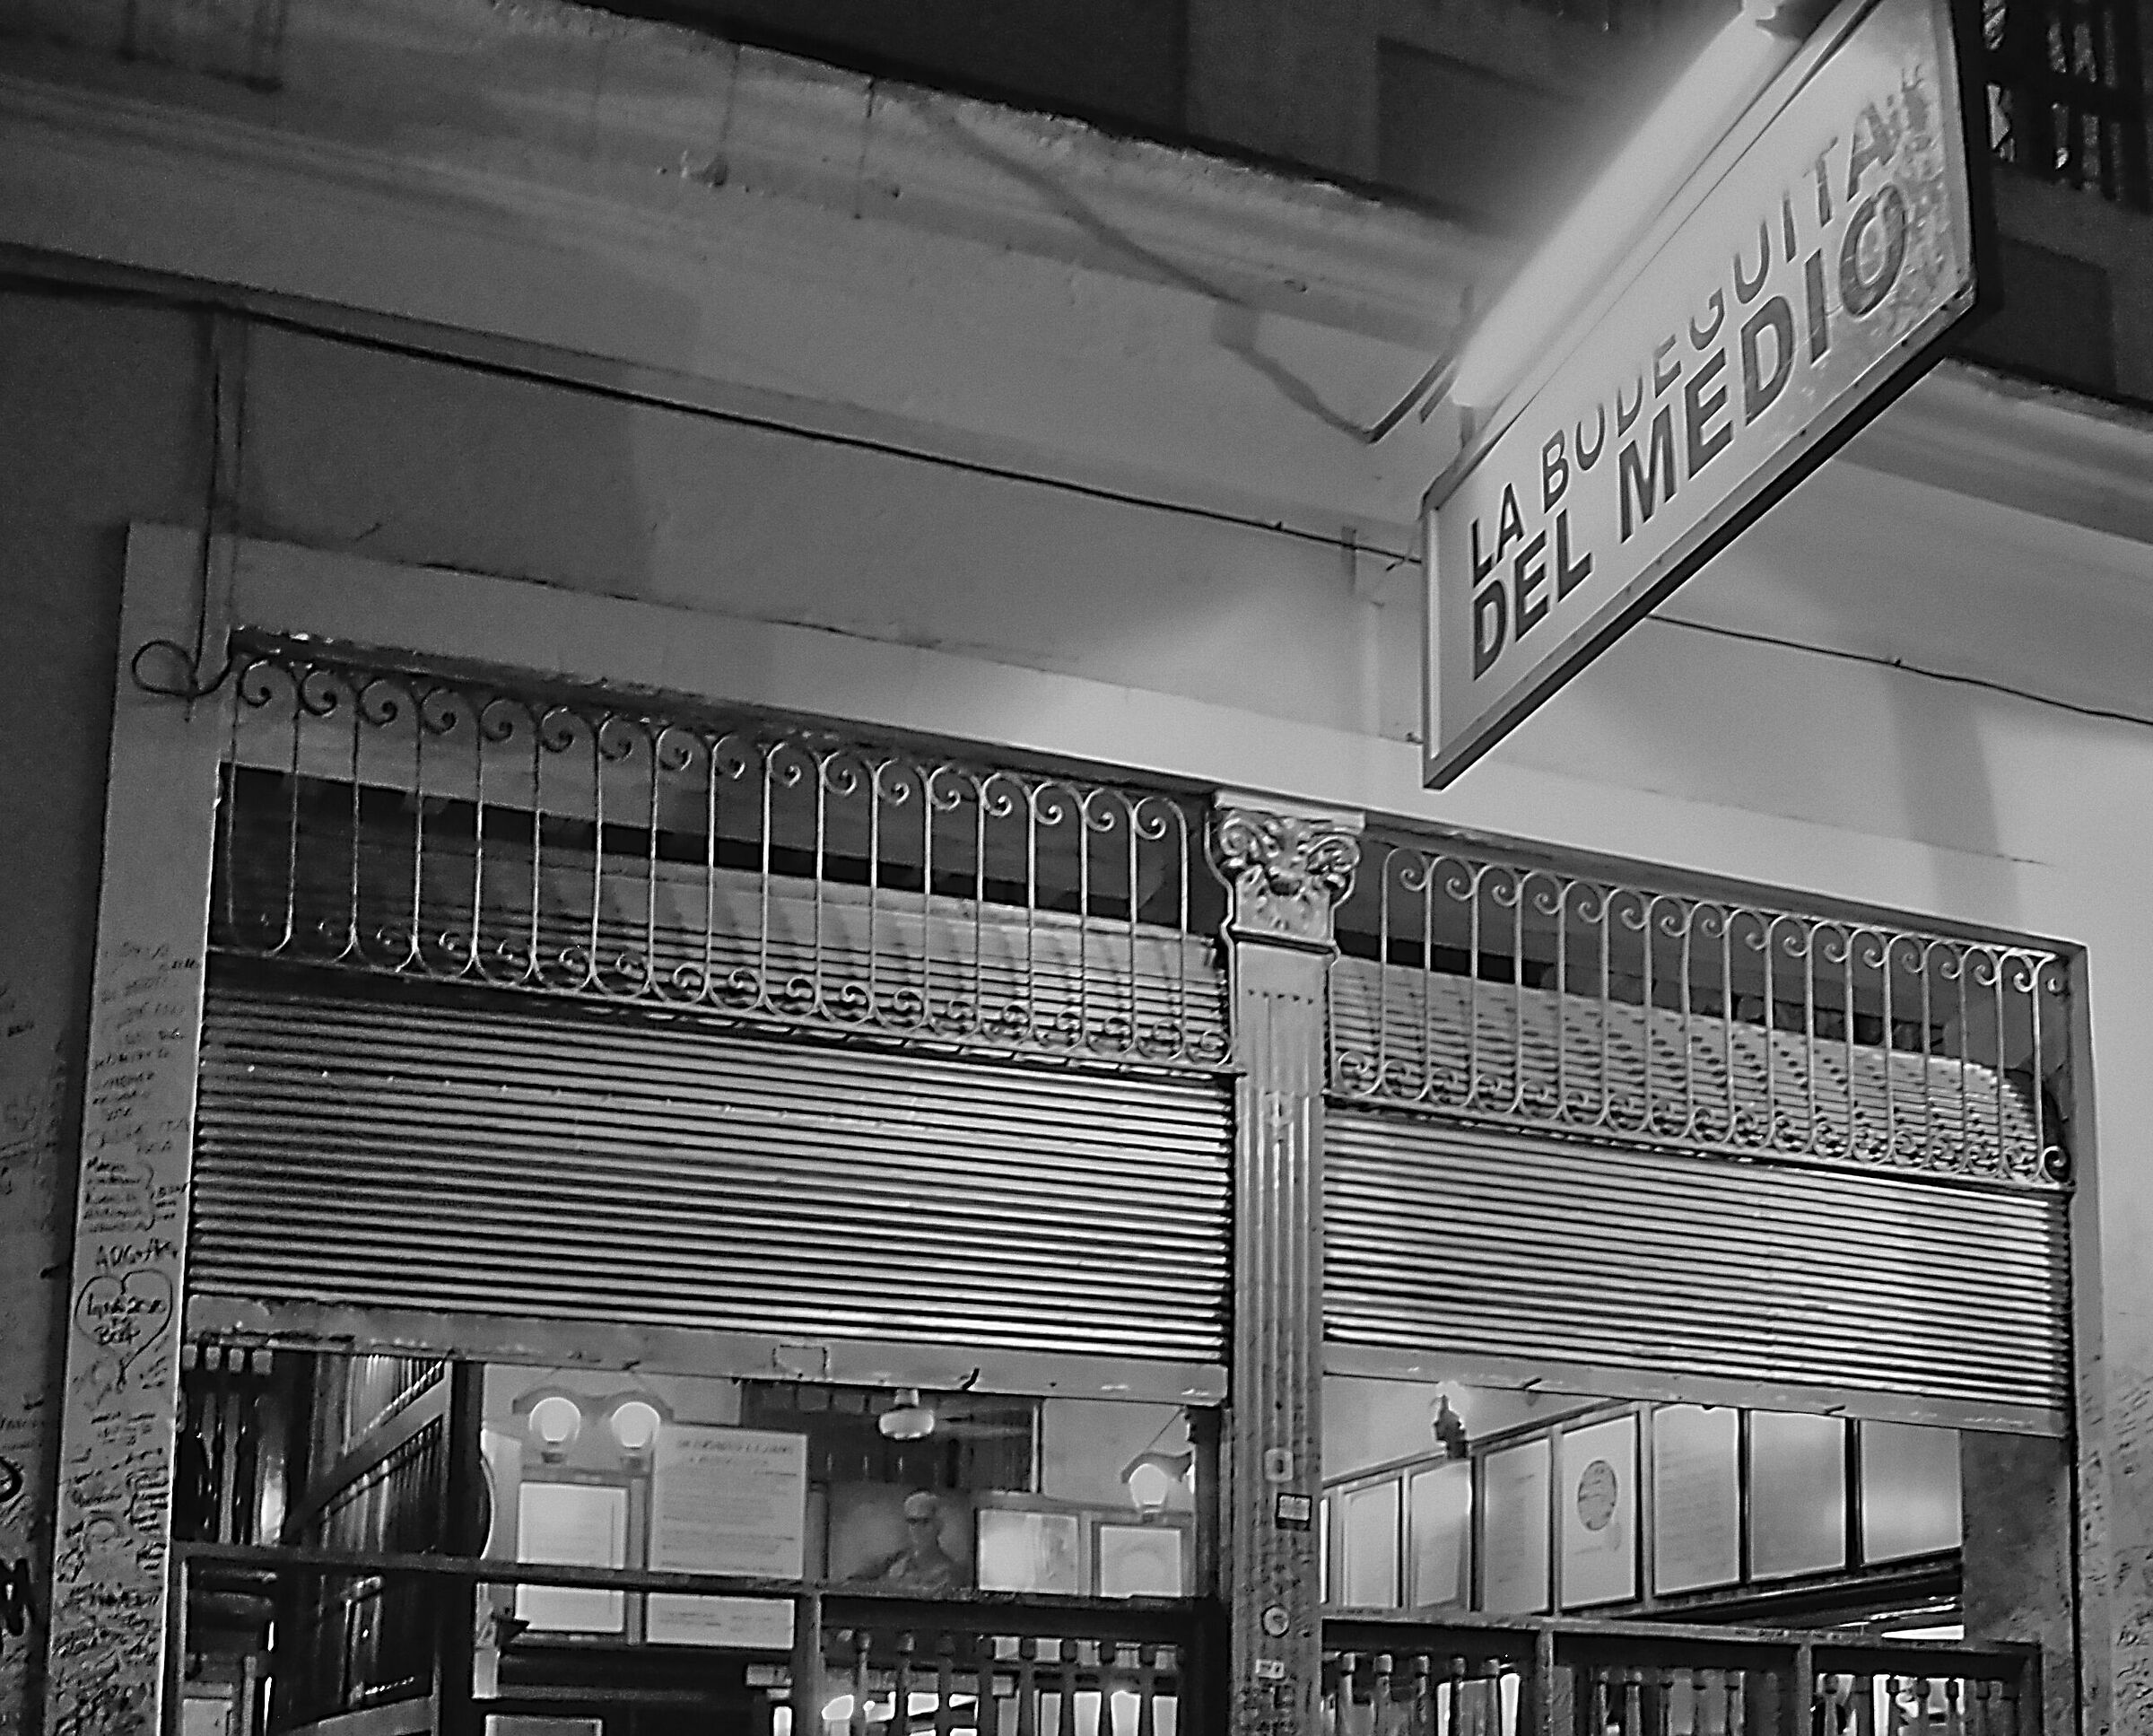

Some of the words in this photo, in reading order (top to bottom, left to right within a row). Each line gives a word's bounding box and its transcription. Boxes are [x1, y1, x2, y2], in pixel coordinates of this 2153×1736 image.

[1470, 483, 1524, 588] LA
[1472, 508, 1593, 681] DEL
[1618, 182, 1909, 544] MEDIO
